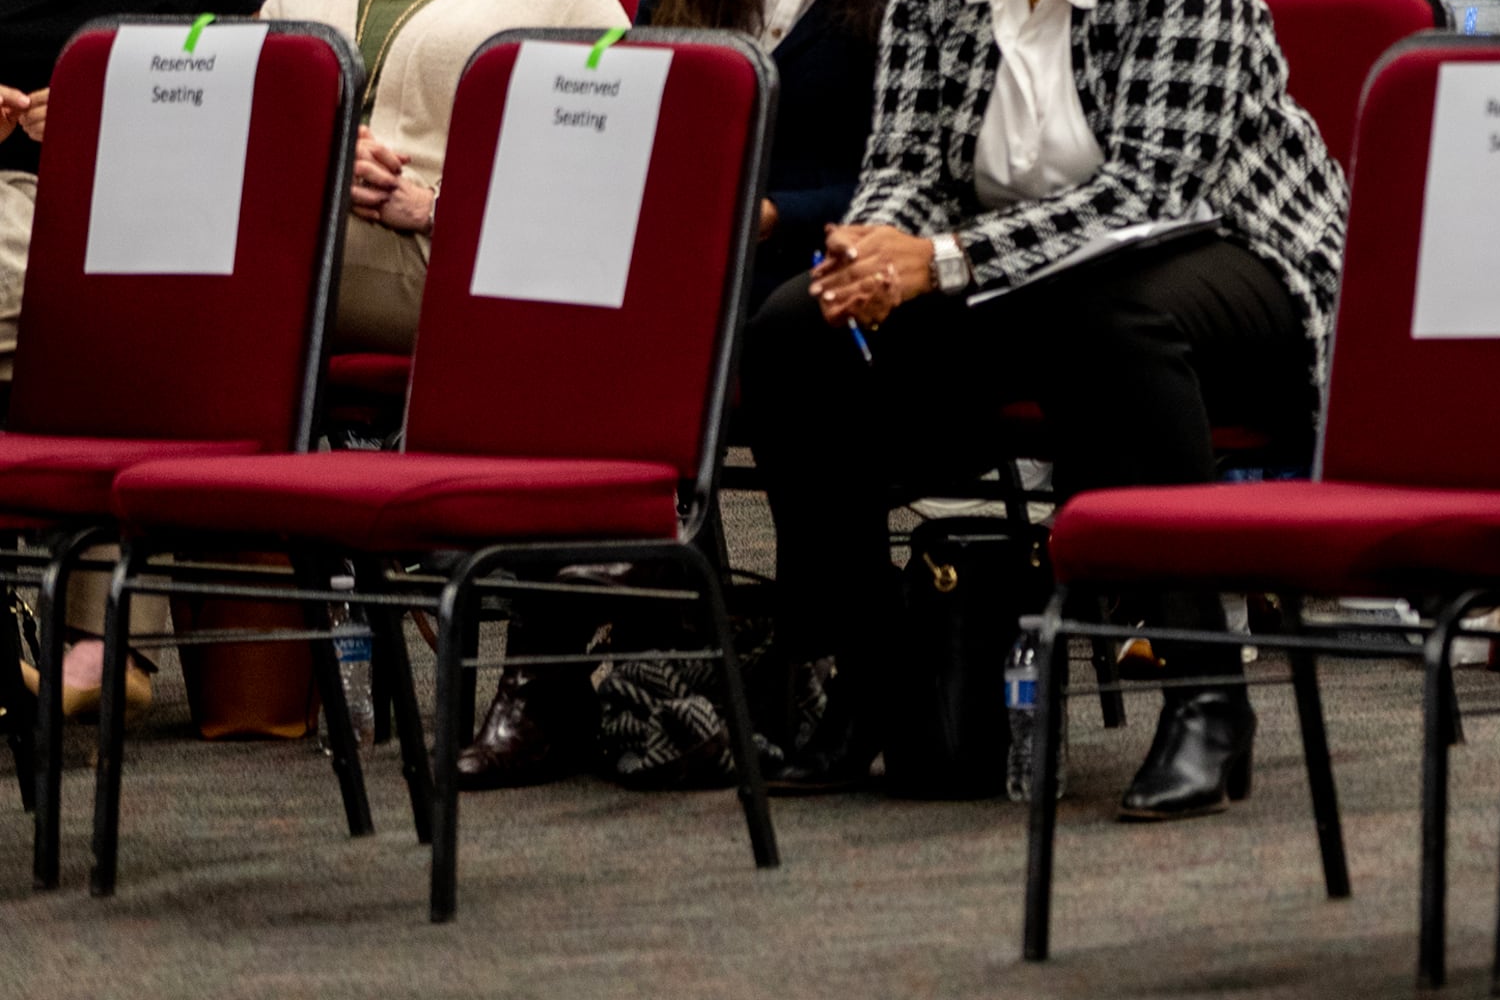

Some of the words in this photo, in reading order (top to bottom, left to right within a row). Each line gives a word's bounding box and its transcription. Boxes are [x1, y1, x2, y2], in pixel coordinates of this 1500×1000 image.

[150, 54, 215, 72] Reserved
[151, 84, 204, 107] Seating
[554, 75, 621, 98] Reserved
[553, 107, 607, 132] Seating
